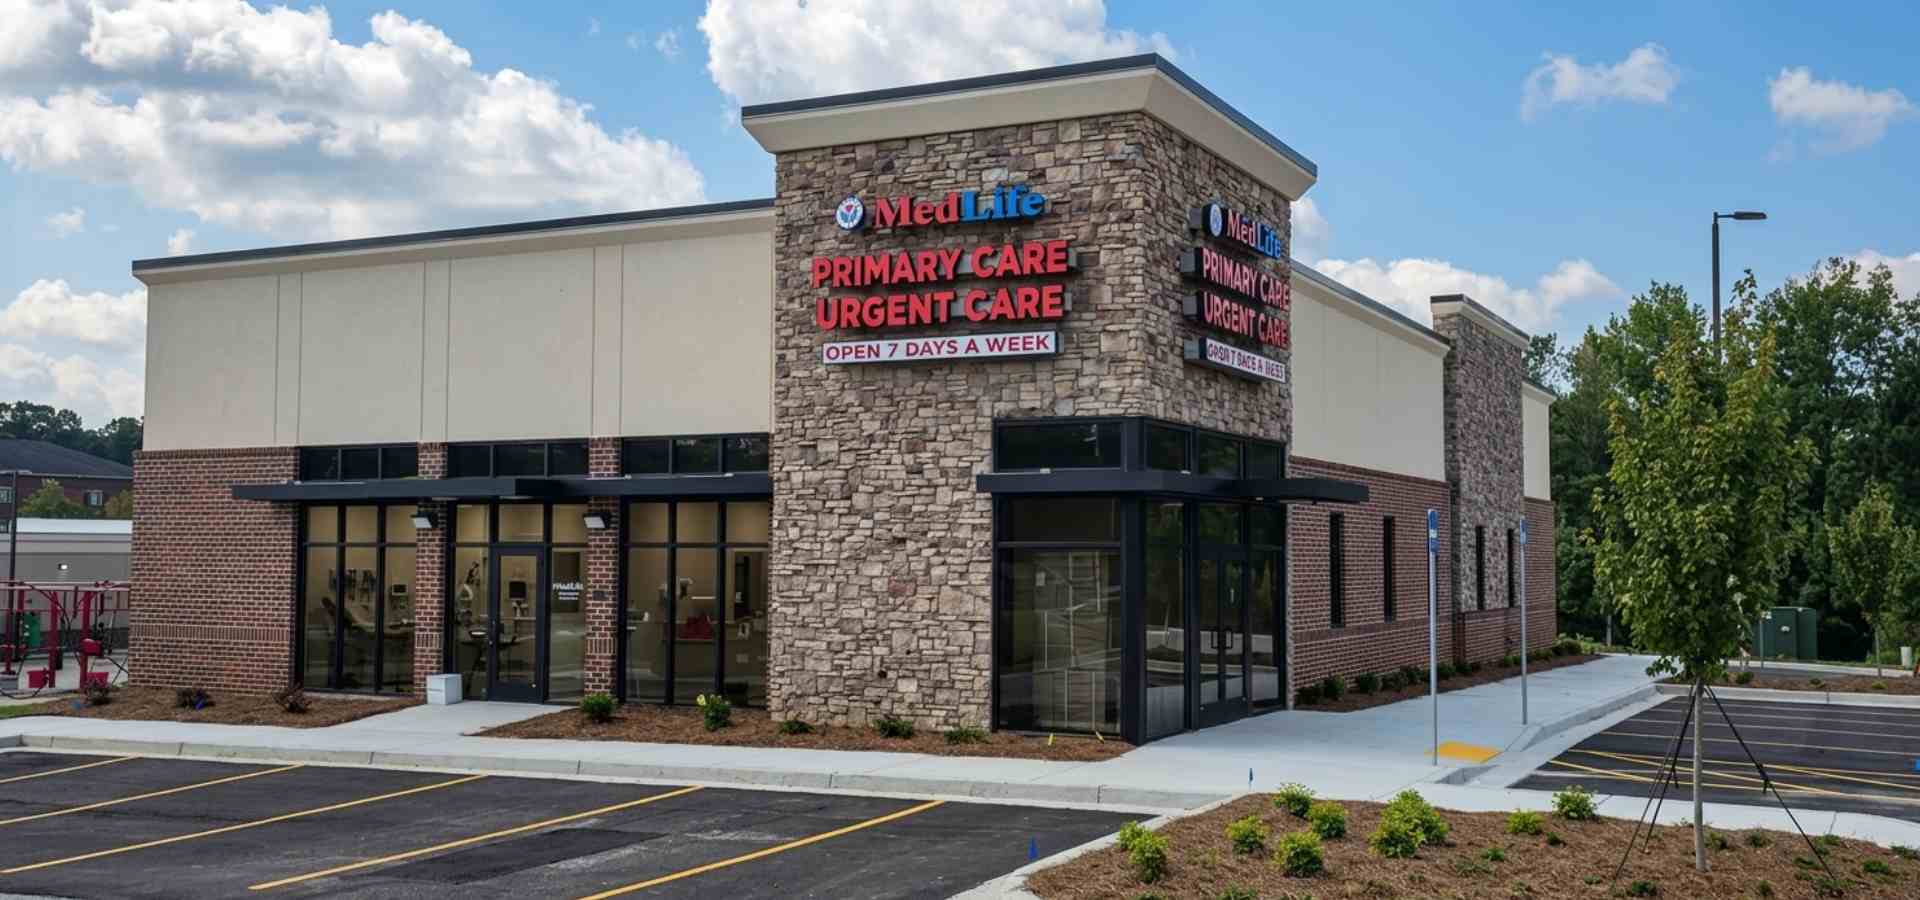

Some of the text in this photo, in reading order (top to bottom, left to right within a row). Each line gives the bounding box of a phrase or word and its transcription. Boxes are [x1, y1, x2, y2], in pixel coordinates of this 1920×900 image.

[874, 183, 1046, 228] MedLife
[1227, 208, 1281, 258] MedLife
[811, 240, 1070, 288] PRIMARY CARE
[1202, 248, 1290, 312] PRIMARY CARE
[815, 284, 1065, 331] URGENT CARE
[1204, 292, 1289, 348] URGENT CARE
[826, 335, 1050, 361] OPEN 7 DAYS A WEEK
